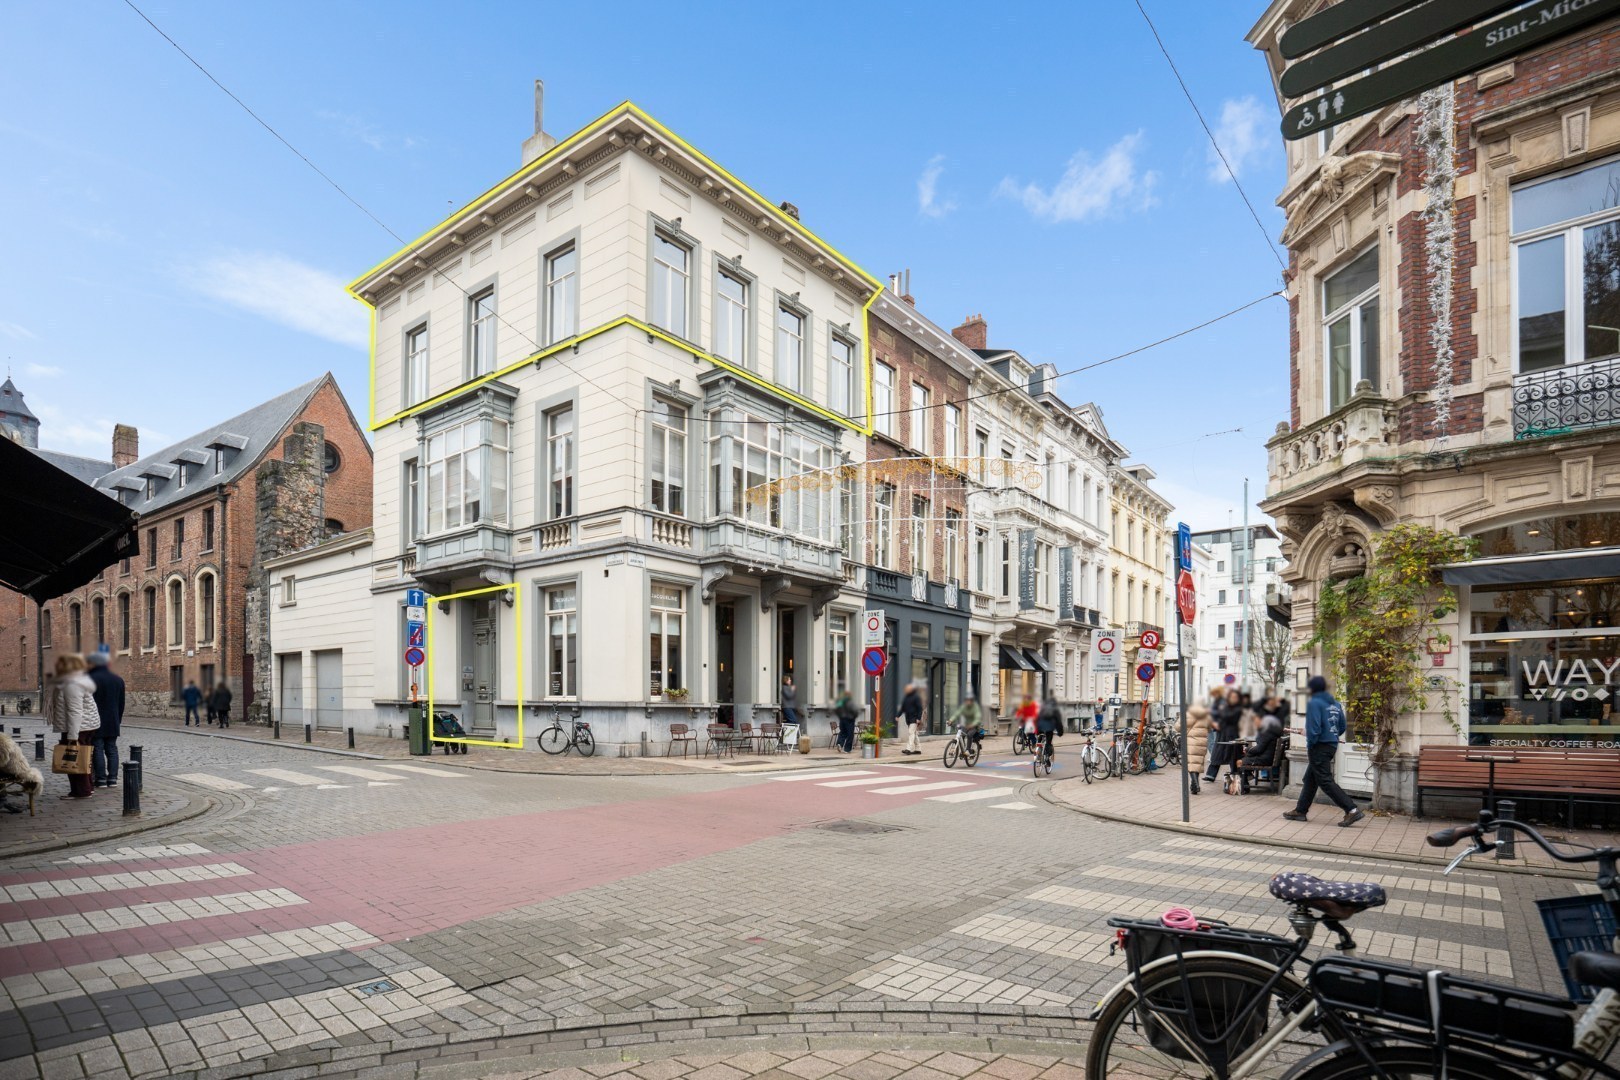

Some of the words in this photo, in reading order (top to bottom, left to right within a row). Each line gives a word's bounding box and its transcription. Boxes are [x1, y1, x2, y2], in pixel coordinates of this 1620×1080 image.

[1180, 586, 1195, 609] STOP
[1097, 630, 1116, 638] ZONE
[1521, 658, 1620, 686] WAY
[1489, 739, 1546, 747] SPECIALTY
[1548, 740, 1594, 748] COFFEE
